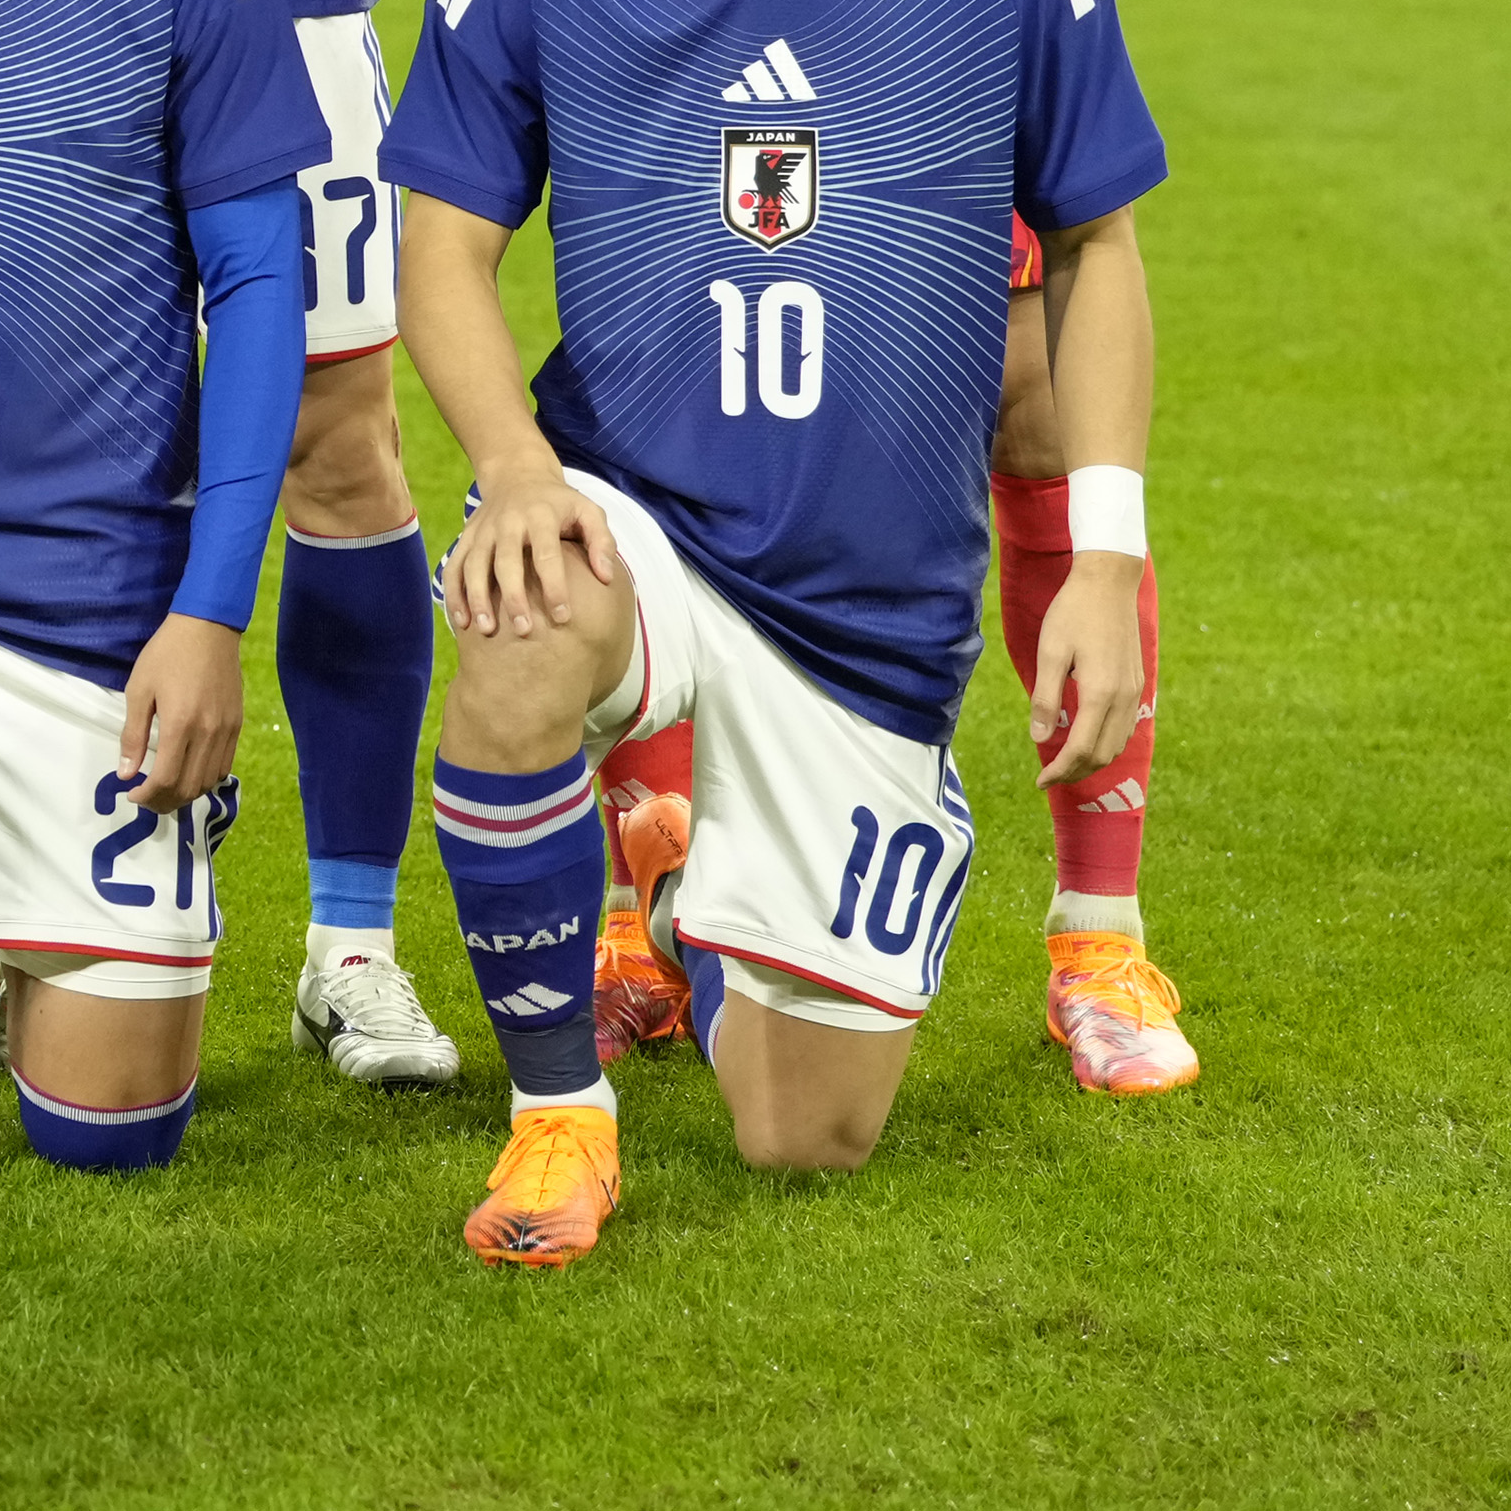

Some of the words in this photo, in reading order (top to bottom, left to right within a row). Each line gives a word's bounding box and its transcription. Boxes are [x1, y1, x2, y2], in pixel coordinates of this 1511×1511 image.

[746, 131, 796, 143] JAPAN
[748, 210, 791, 229] JFA
[710, 279, 824, 419] 10
[91, 770, 195, 911] 21
[830, 805, 945, 956] 10
